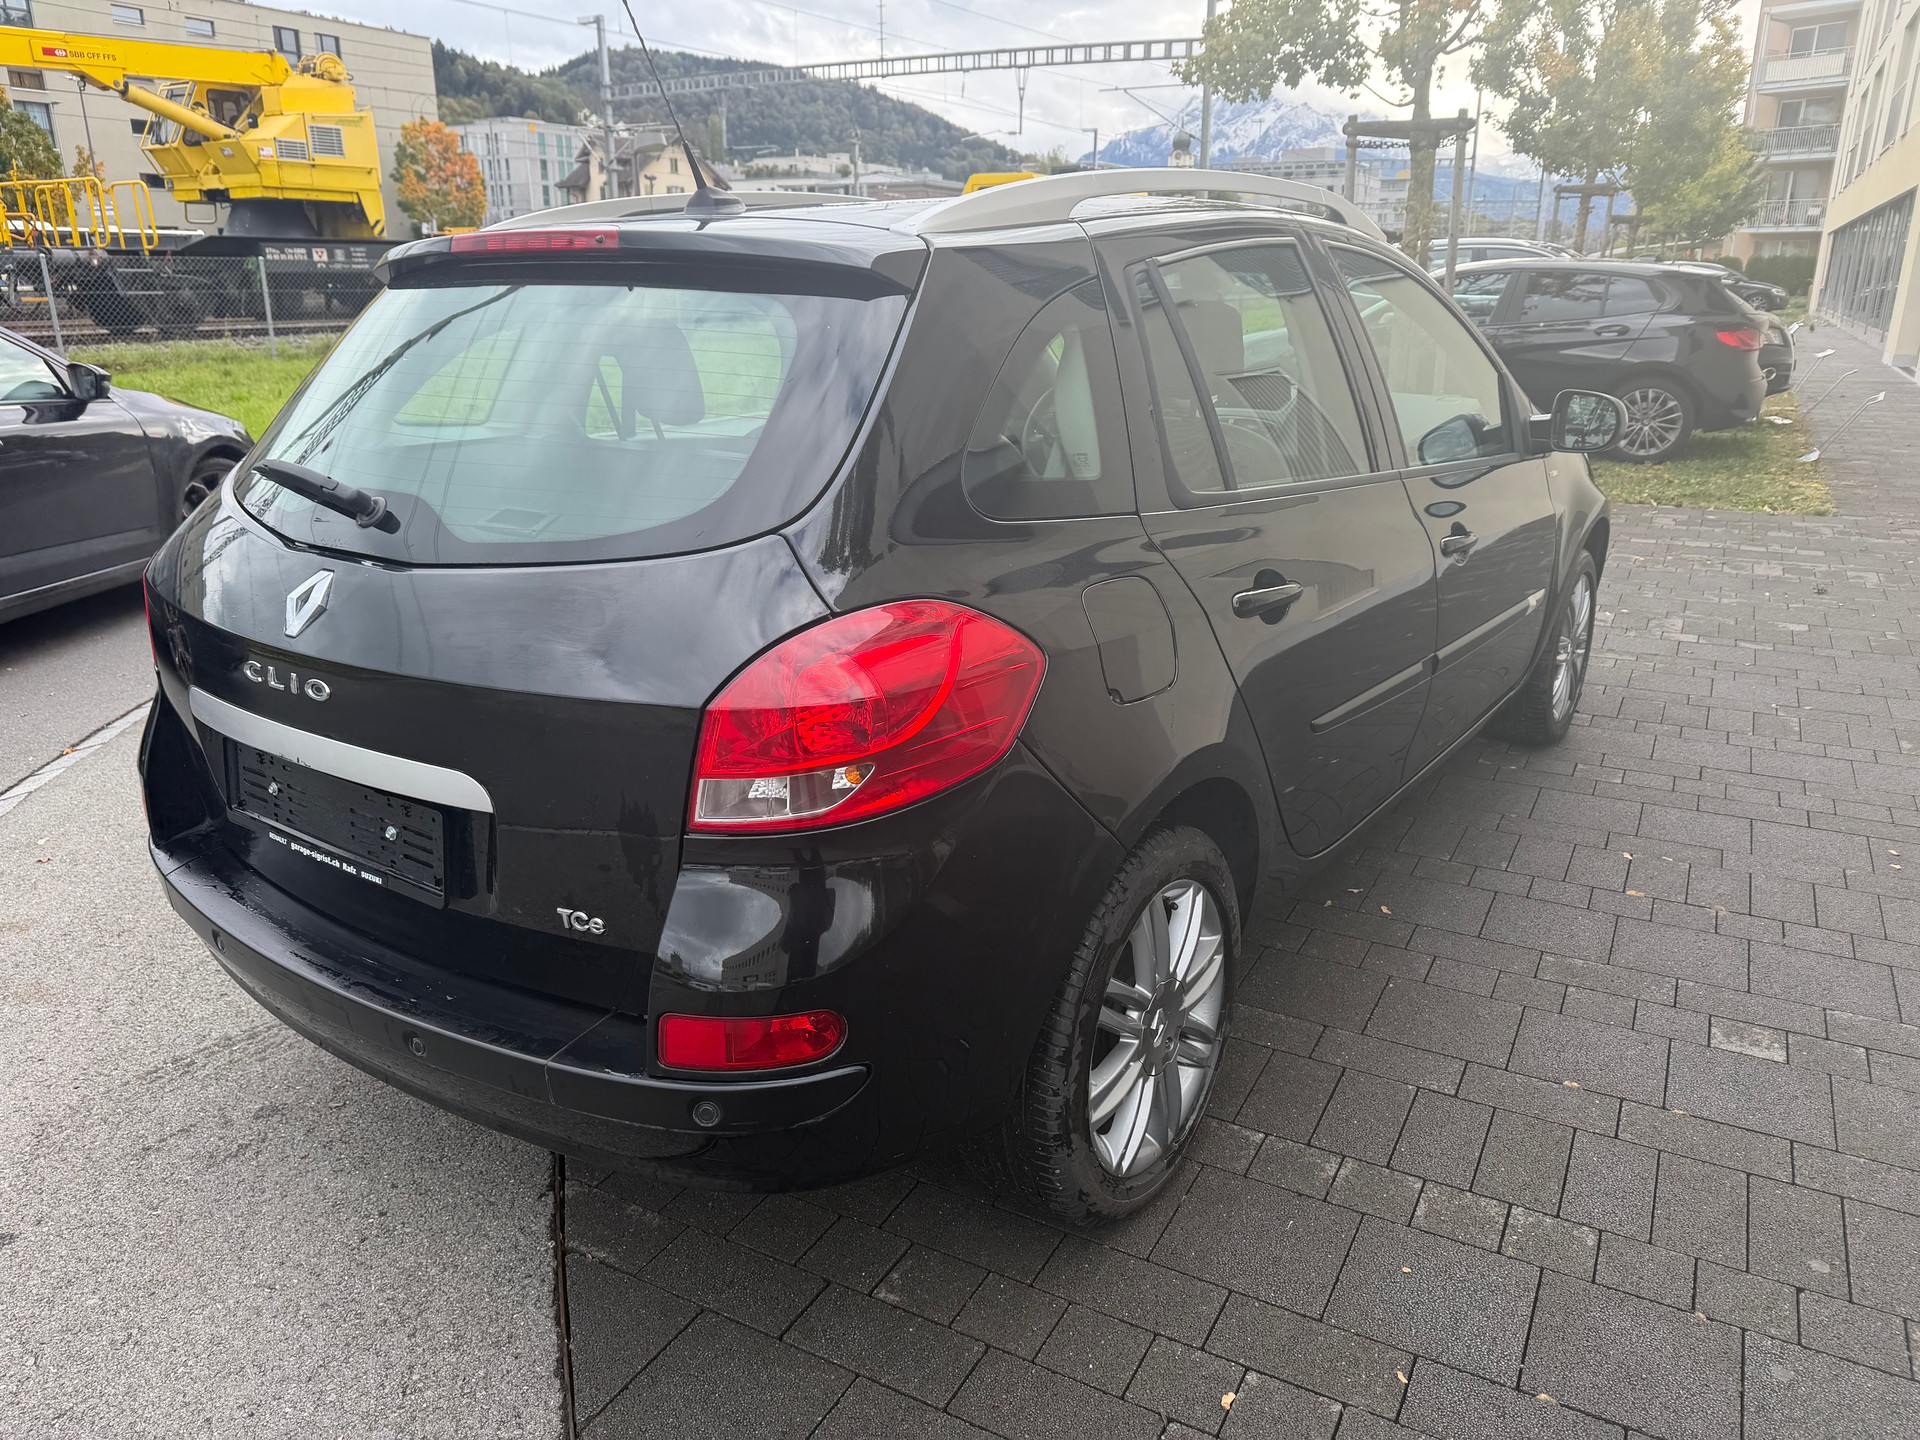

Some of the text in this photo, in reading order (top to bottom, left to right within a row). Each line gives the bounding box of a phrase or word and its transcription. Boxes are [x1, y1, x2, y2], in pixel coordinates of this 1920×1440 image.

[86, 52, 101, 60] CFF
[243, 660, 332, 702] CLIO
[269, 831, 382, 885] RENAULT garage-sigrist.ch Rafz SUZUKI
